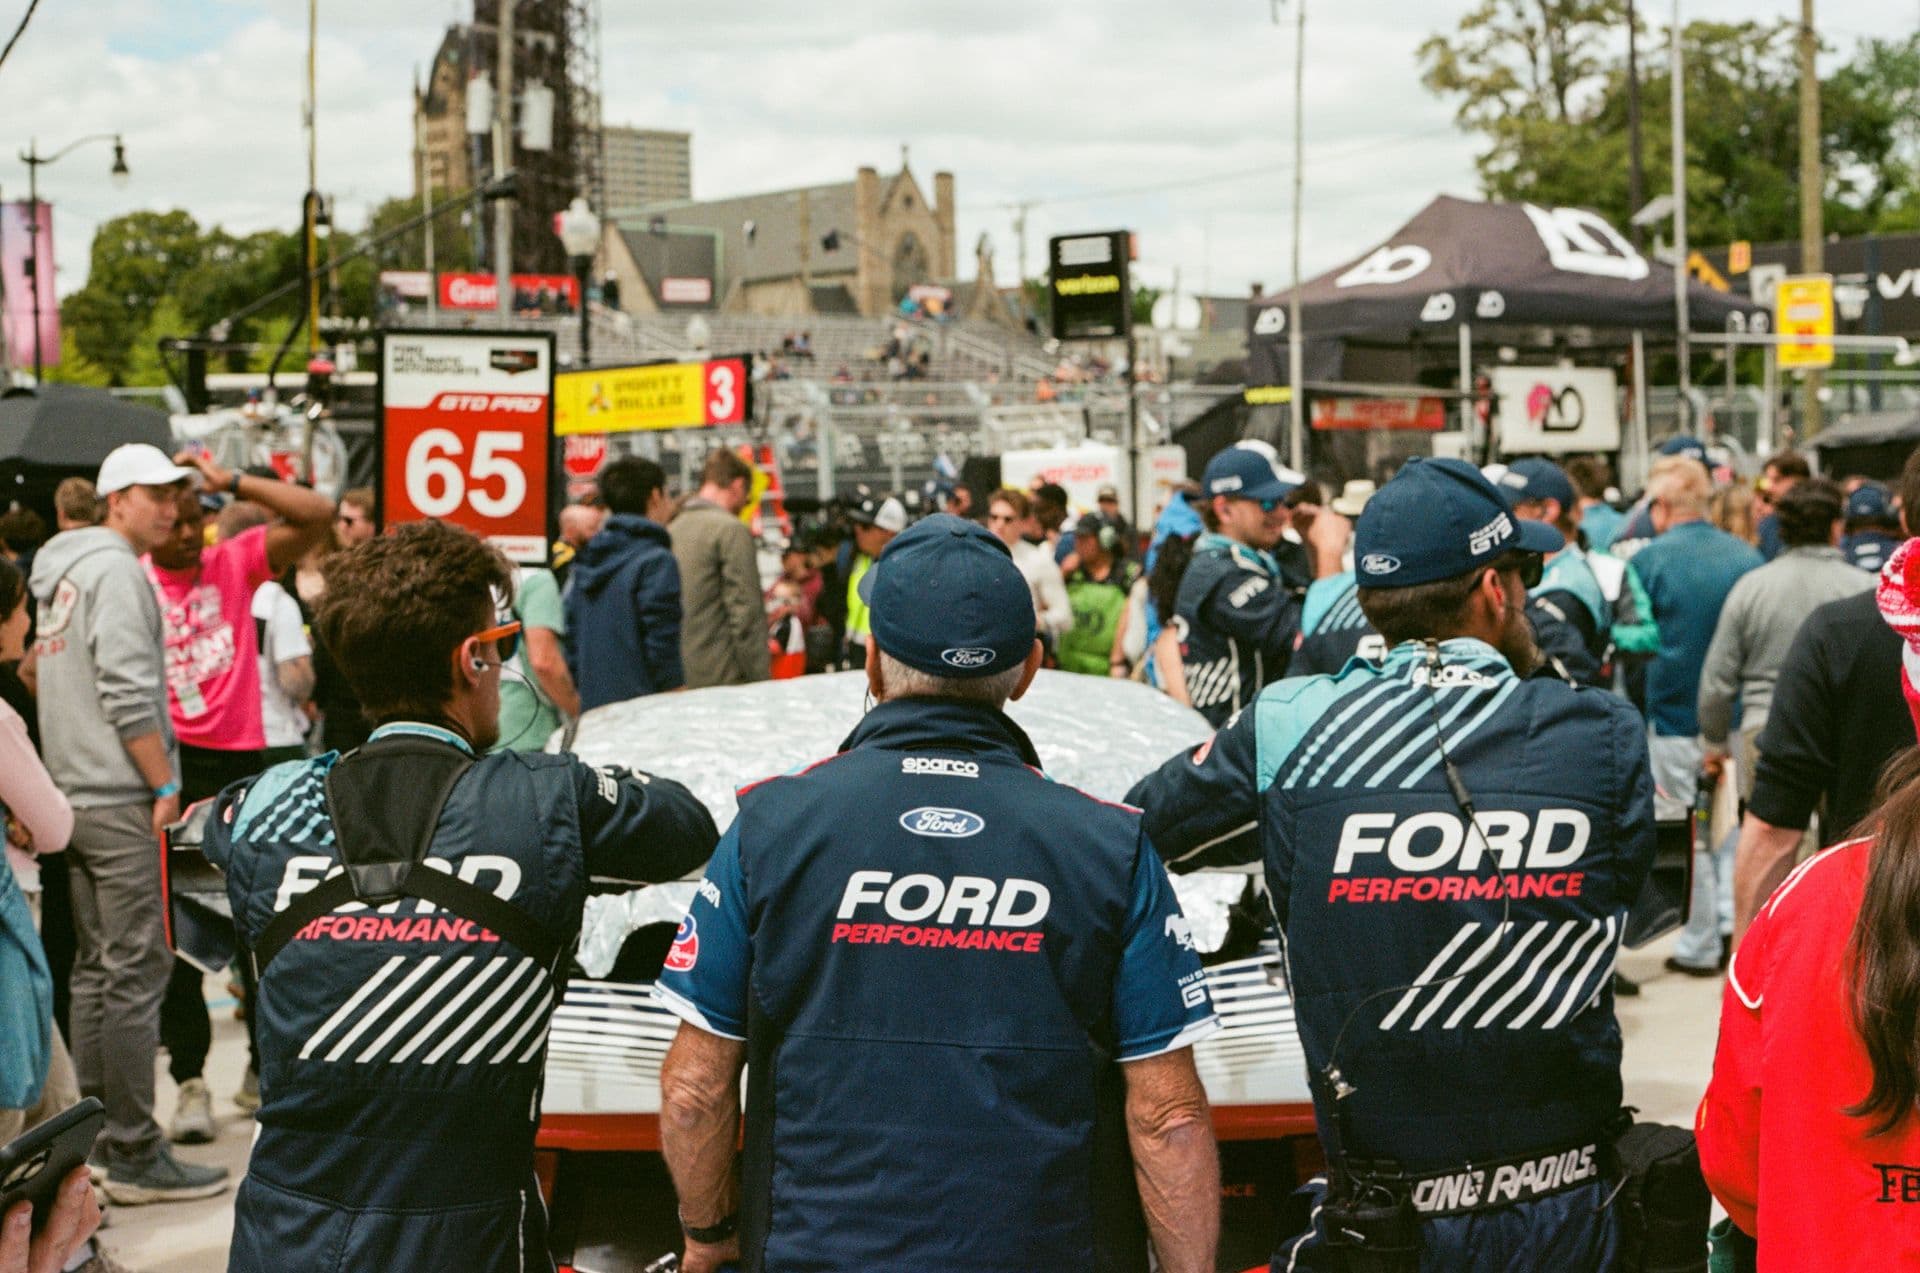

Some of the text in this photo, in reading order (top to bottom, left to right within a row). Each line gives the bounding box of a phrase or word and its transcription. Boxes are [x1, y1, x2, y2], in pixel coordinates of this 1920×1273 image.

[709, 366, 736, 420] 3
[405, 428, 527, 518] 65
[902, 757, 979, 776] sparco
[915, 809, 968, 834] Ford
[1333, 808, 1591, 874] FORD
[836, 870, 1051, 927] FORD
[1328, 872, 1584, 903] PERFORMANCE
[831, 923, 1045, 953] PERFORMANCE
